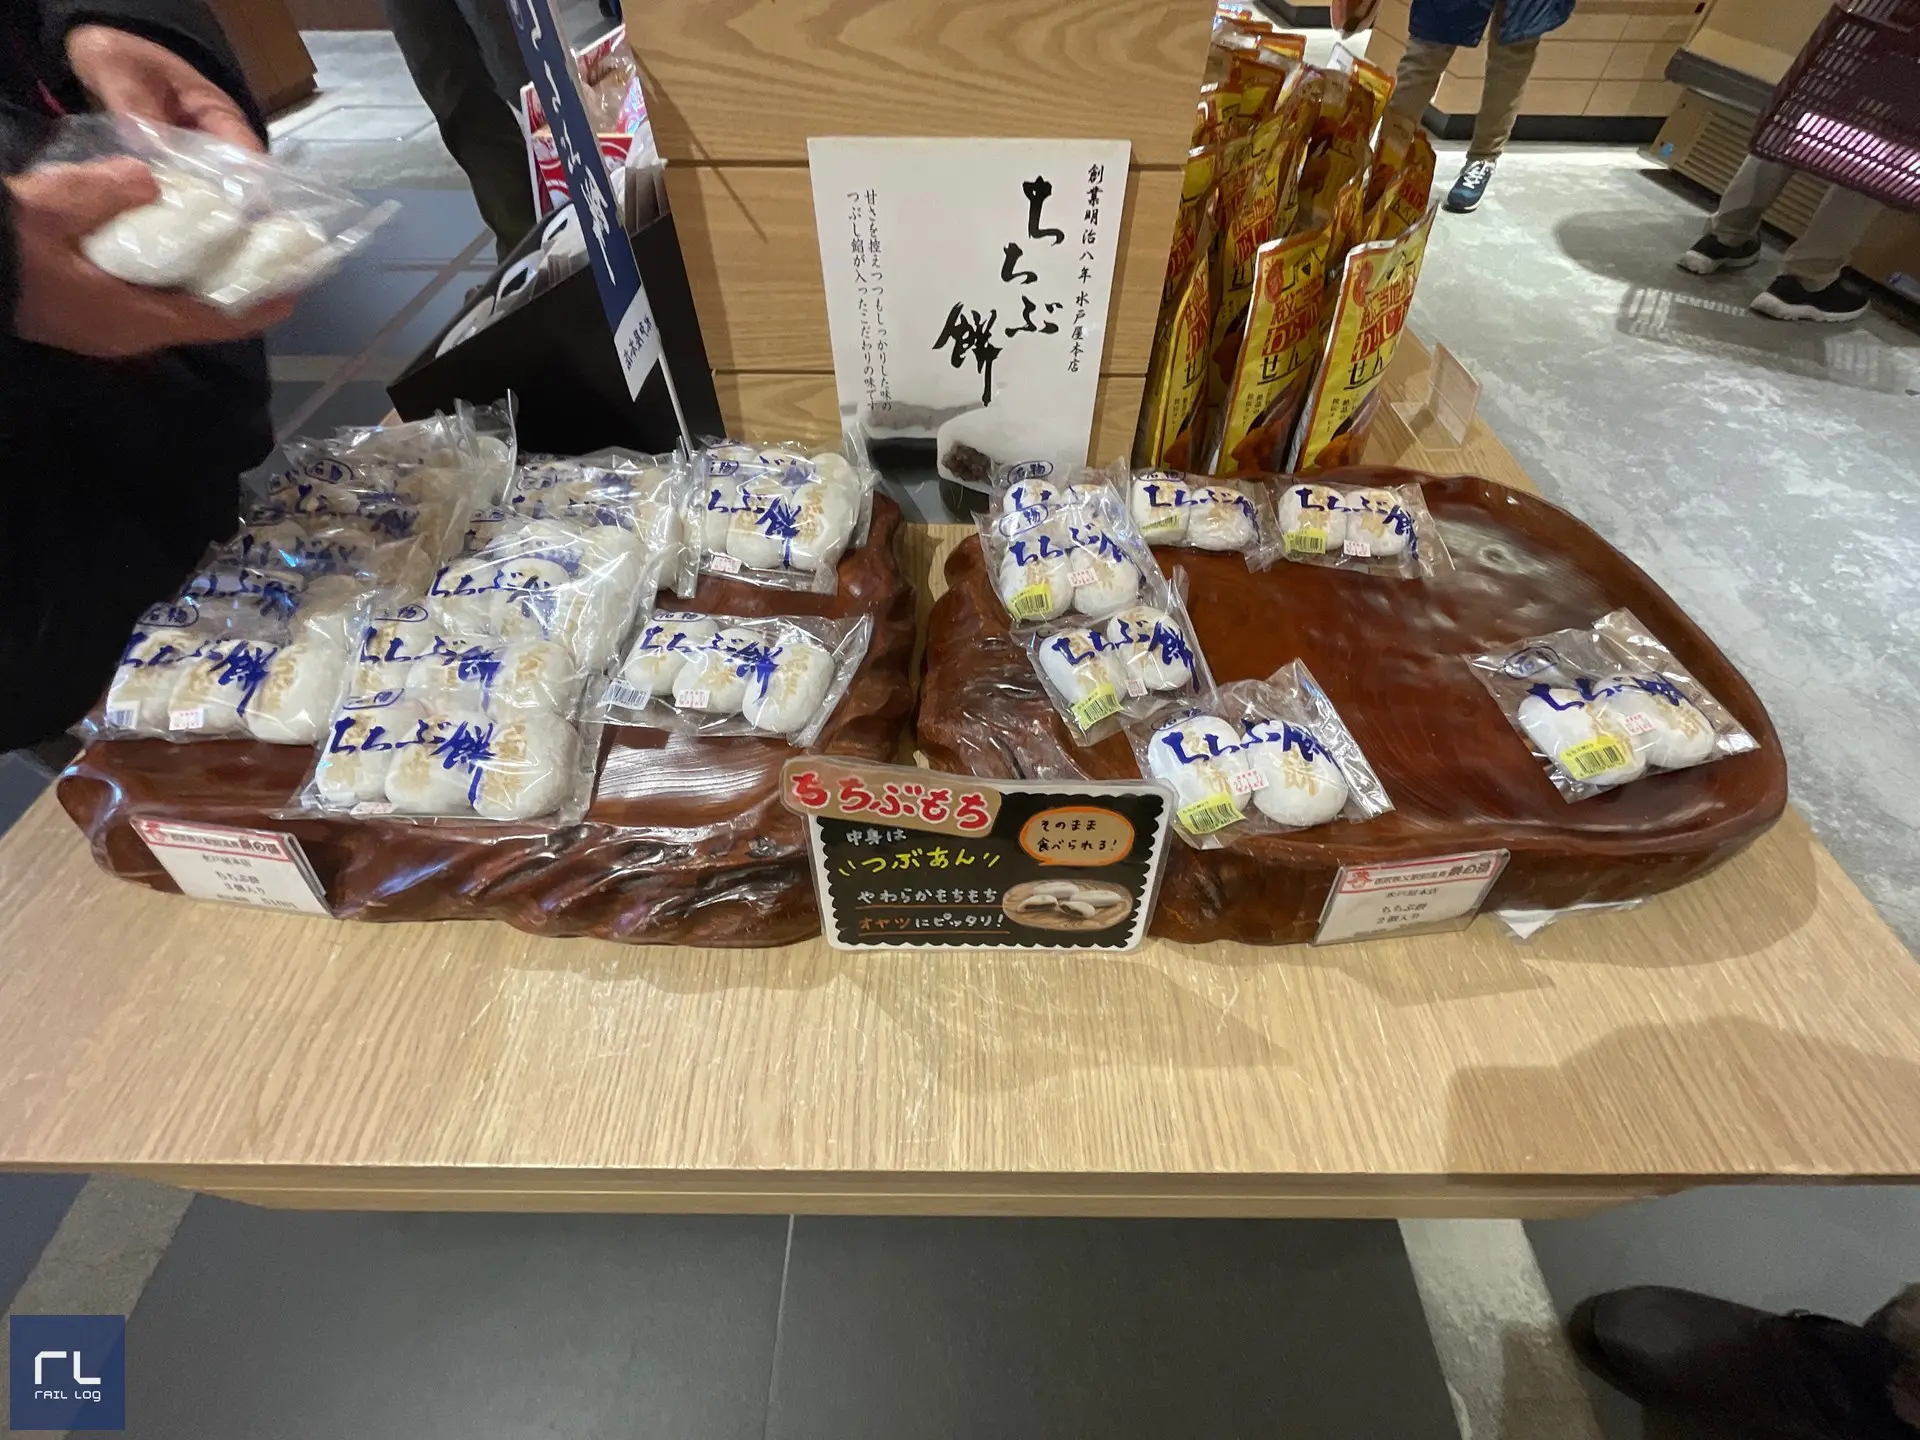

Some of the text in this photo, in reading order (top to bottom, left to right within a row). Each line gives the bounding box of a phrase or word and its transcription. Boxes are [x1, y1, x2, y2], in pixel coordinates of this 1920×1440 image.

[1067, 163, 1104, 372] 創業明治八年 水戸屋本店
[1051, 618, 1200, 693] ちちぶ餅
[790, 770, 990, 831] ちちぶもち
[1040, 818, 1097, 832] そのまま
[845, 829, 907, 846] 中身は
[1036, 837, 1119, 854] 食べられる!
[857, 887, 998, 904] やわらかもちもち
[859, 913, 1004, 930] オヤツにピッタリ!
